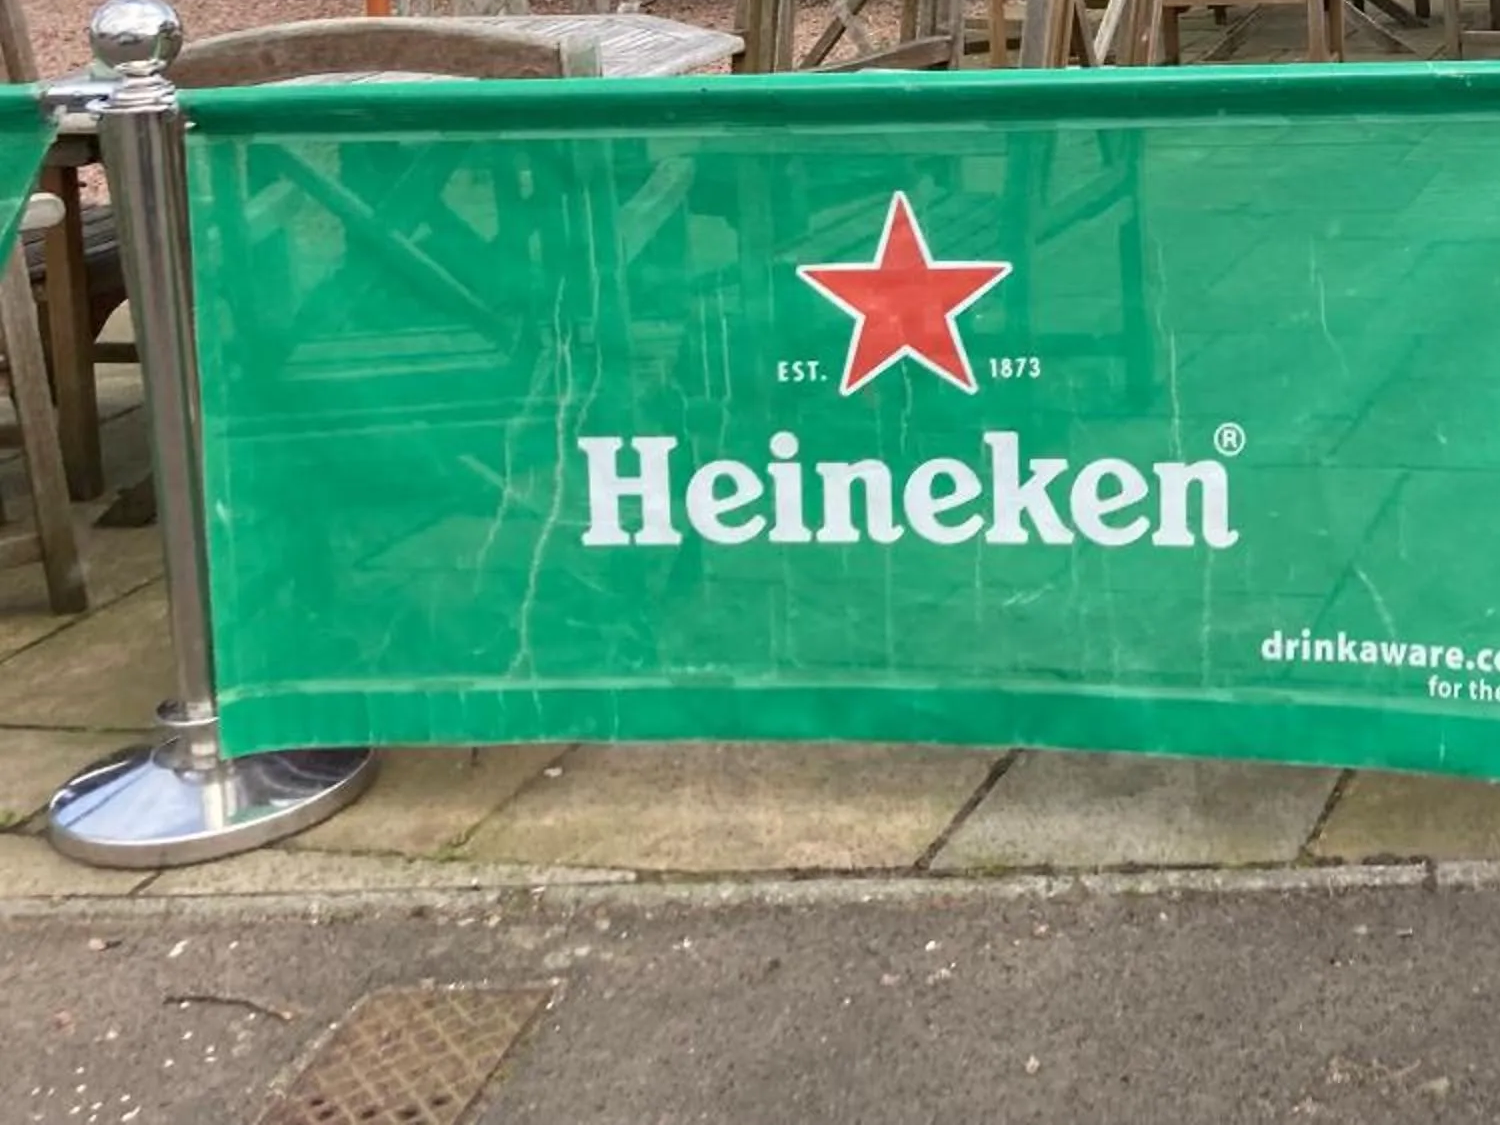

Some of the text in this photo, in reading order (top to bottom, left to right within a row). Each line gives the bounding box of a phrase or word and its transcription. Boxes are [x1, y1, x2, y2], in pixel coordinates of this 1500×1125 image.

[777, 357, 1041, 381] EST. 1873
[1427, 674, 1463, 700] for
